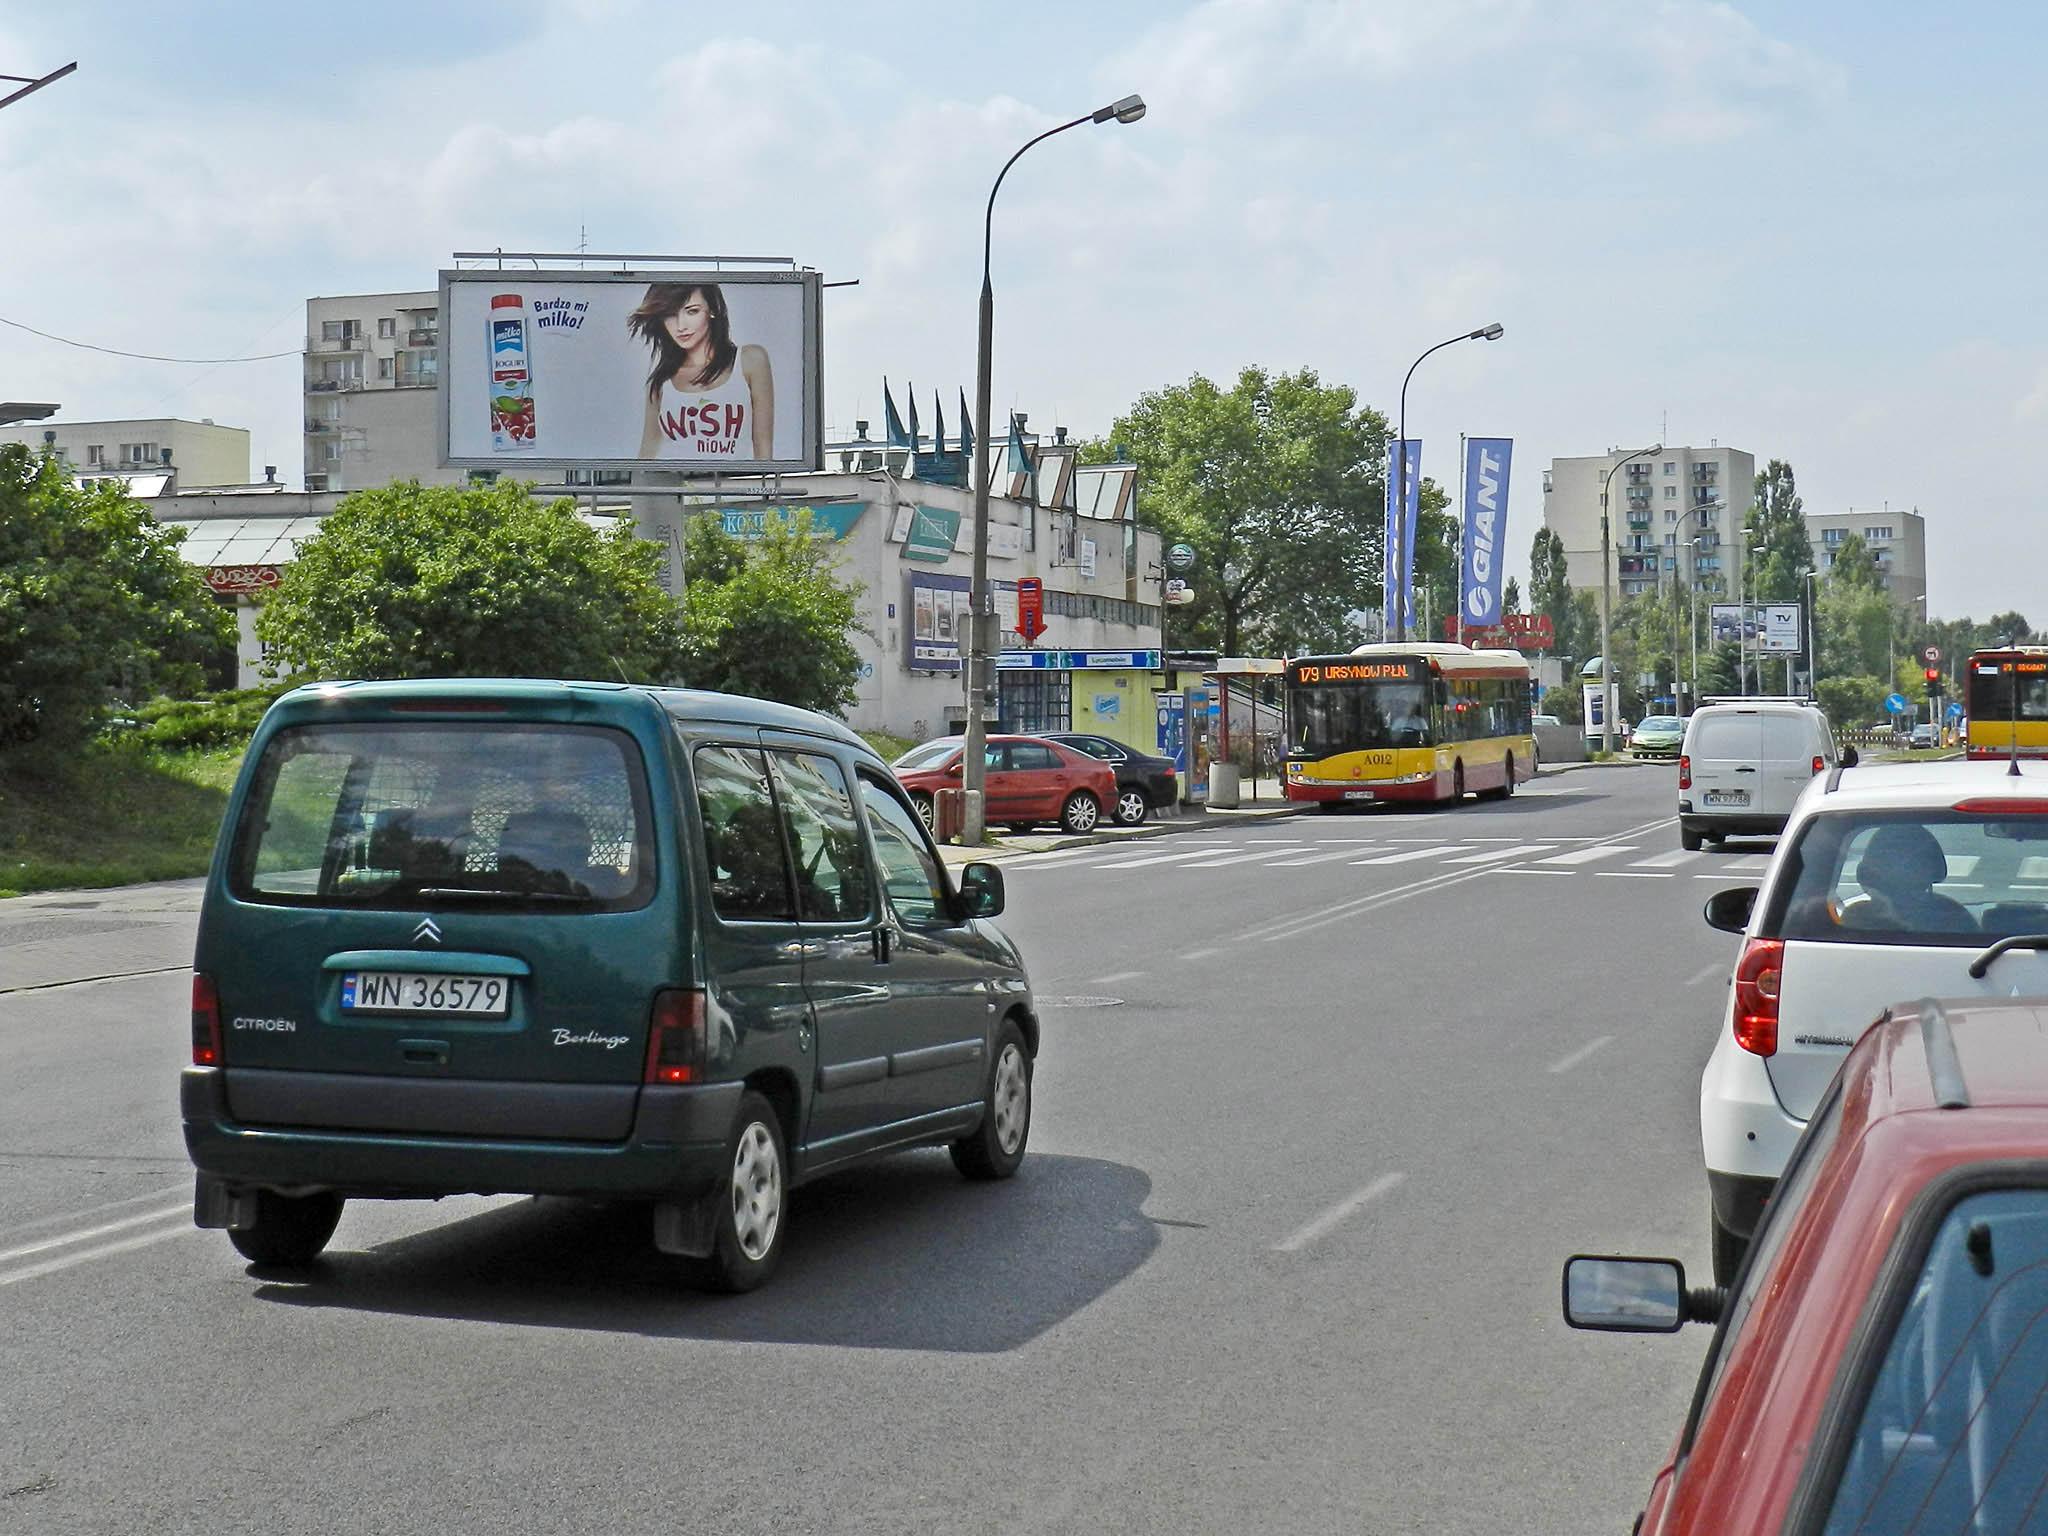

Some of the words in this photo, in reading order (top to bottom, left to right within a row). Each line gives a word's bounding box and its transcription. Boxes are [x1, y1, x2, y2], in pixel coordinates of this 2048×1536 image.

[534, 297, 572, 312] Bardzo
[574, 302, 589, 312] mi
[538, 311, 585, 329] milko!
[496, 326, 521, 340] milko
[1472, 448, 1500, 582] GIANT
[1300, 667, 1319, 681] 179
[1364, 754, 1393, 765] A012
[343, 994, 353, 1002] PL
[361, 975, 400, 1006] WN
[412, 977, 501, 1010] 36579
[233, 1017, 297, 1032] CITROËN
[552, 1028, 630, 1049] Berlingo
